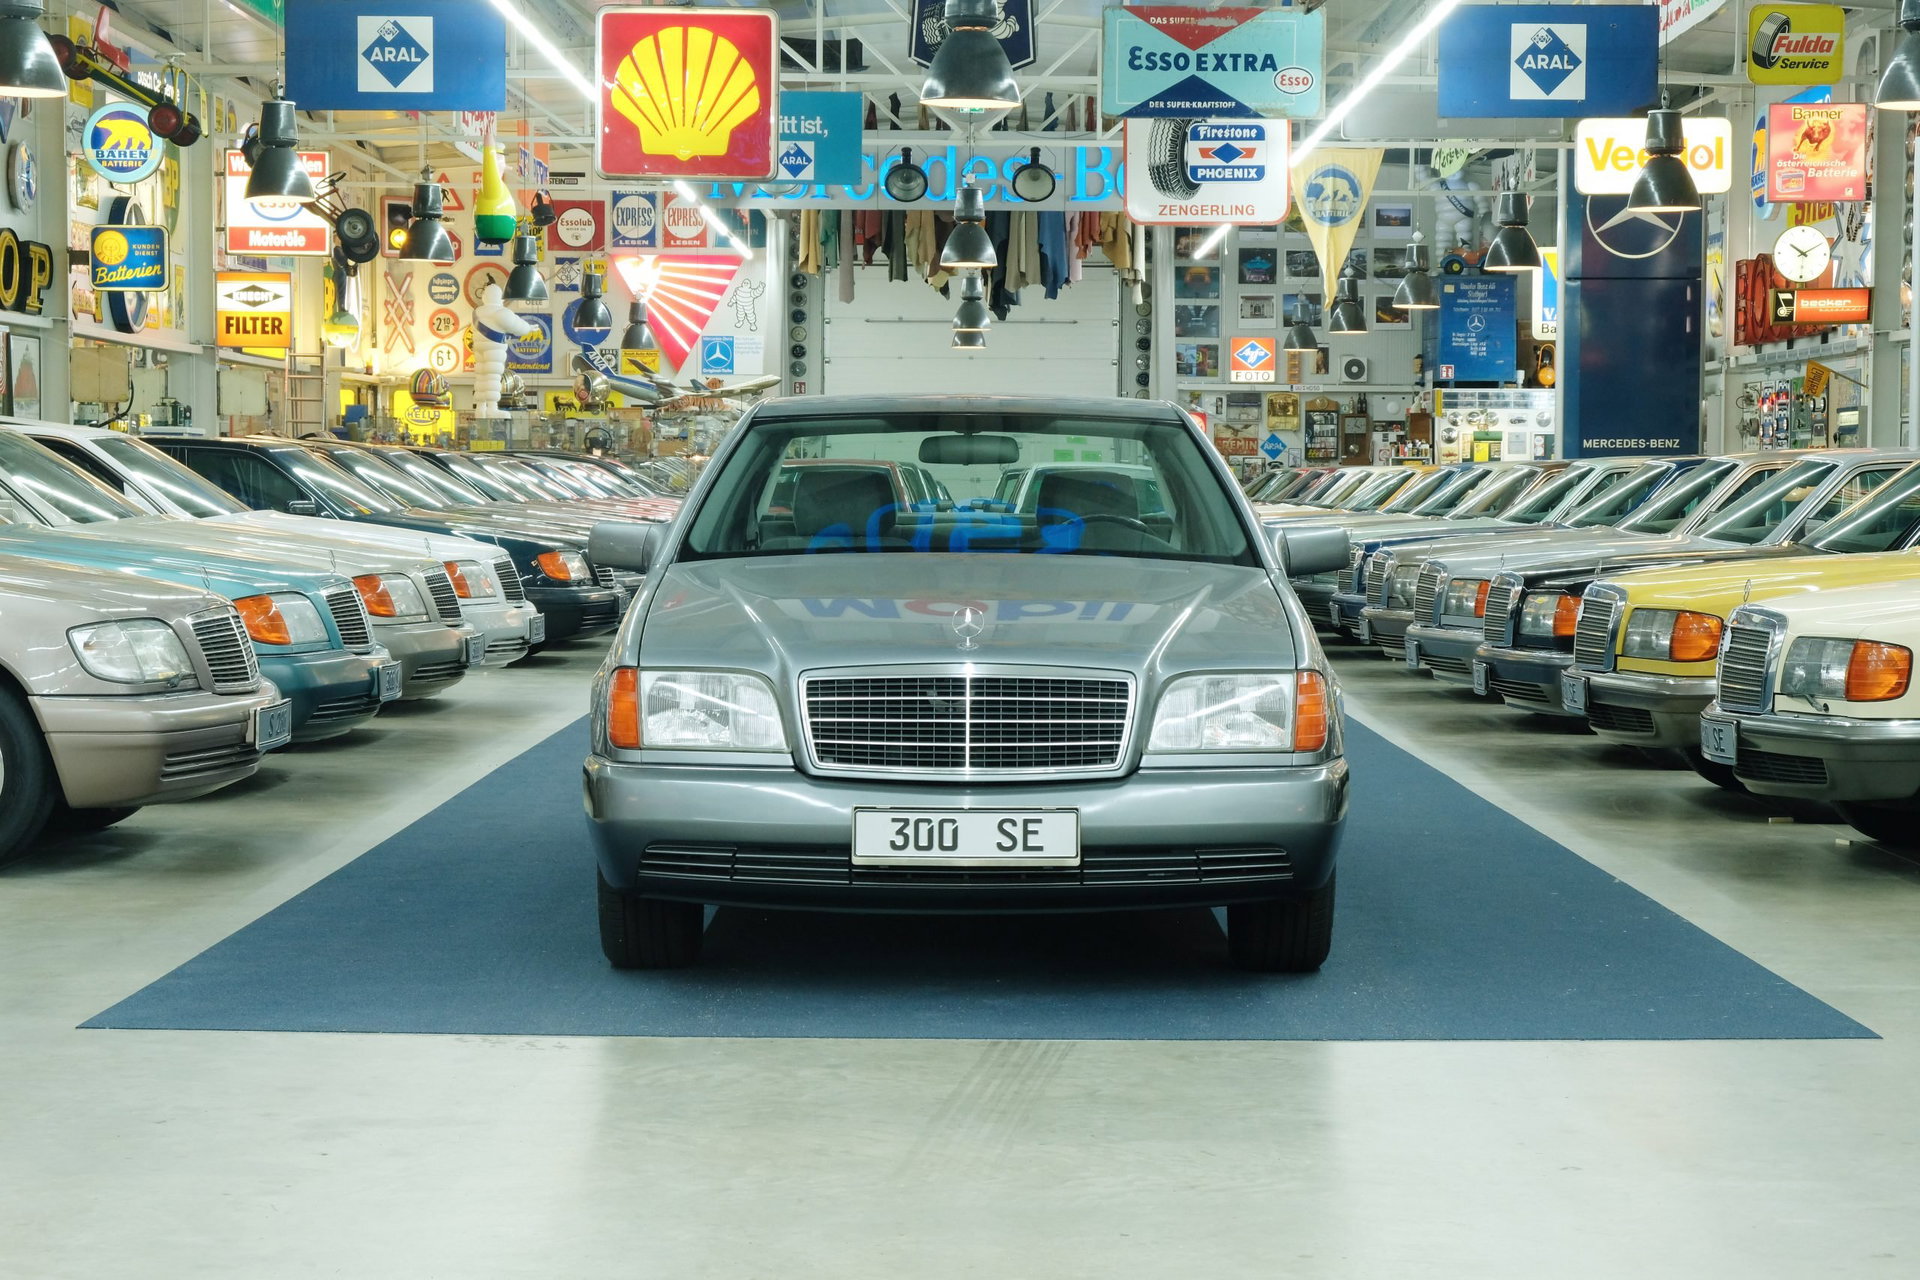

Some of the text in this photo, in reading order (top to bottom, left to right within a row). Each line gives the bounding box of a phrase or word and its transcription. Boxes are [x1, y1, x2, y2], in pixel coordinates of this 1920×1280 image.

[1150, 17, 1167, 25] DAS
[1773, 35, 1835, 54] Fulda
[370, 46, 421, 62] ARAL
[1195, 53, 1278, 72] EXTRA
[1522, 54, 1574, 70] ARAL
[1780, 58, 1829, 69] Service
[1149, 101, 1236, 109] DER SUPER-KRAFTSTOFF
[1792, 107, 1844, 120] Banner
[800, 115, 829, 138] ist,
[1198, 124, 1258, 140] Firestone
[95, 149, 148, 160] BÄREN
[781, 156, 809, 166] ARAL
[1792, 151, 1807, 160] Die
[101, 160, 144, 168] BATTERIE
[1197, 168, 1258, 179] PHOENIX
[1807, 167, 1858, 178] Batterie
[616, 206, 653, 227] EXPRESS
[667, 206, 704, 227] EXPRESS
[1158, 204, 1256, 216] ZENGERLING
[560, 218, 592, 227] Essolub
[249, 229, 306, 247] Motoröle
[94, 262, 162, 284] Batterien
[1801, 299, 1852, 308] becker
[225, 316, 283, 335] FILTER
[436, 350, 444, 367] 6
[587, 351, 607, 372] ANA
[1235, 371, 1270, 381] FOTO
[1263, 442, 1285, 450] ARAL
[1582, 438, 1680, 449] MERCEDES-BENZ
[1713, 726, 1726, 753] SE
[889, 817, 1044, 852] 300 SE
